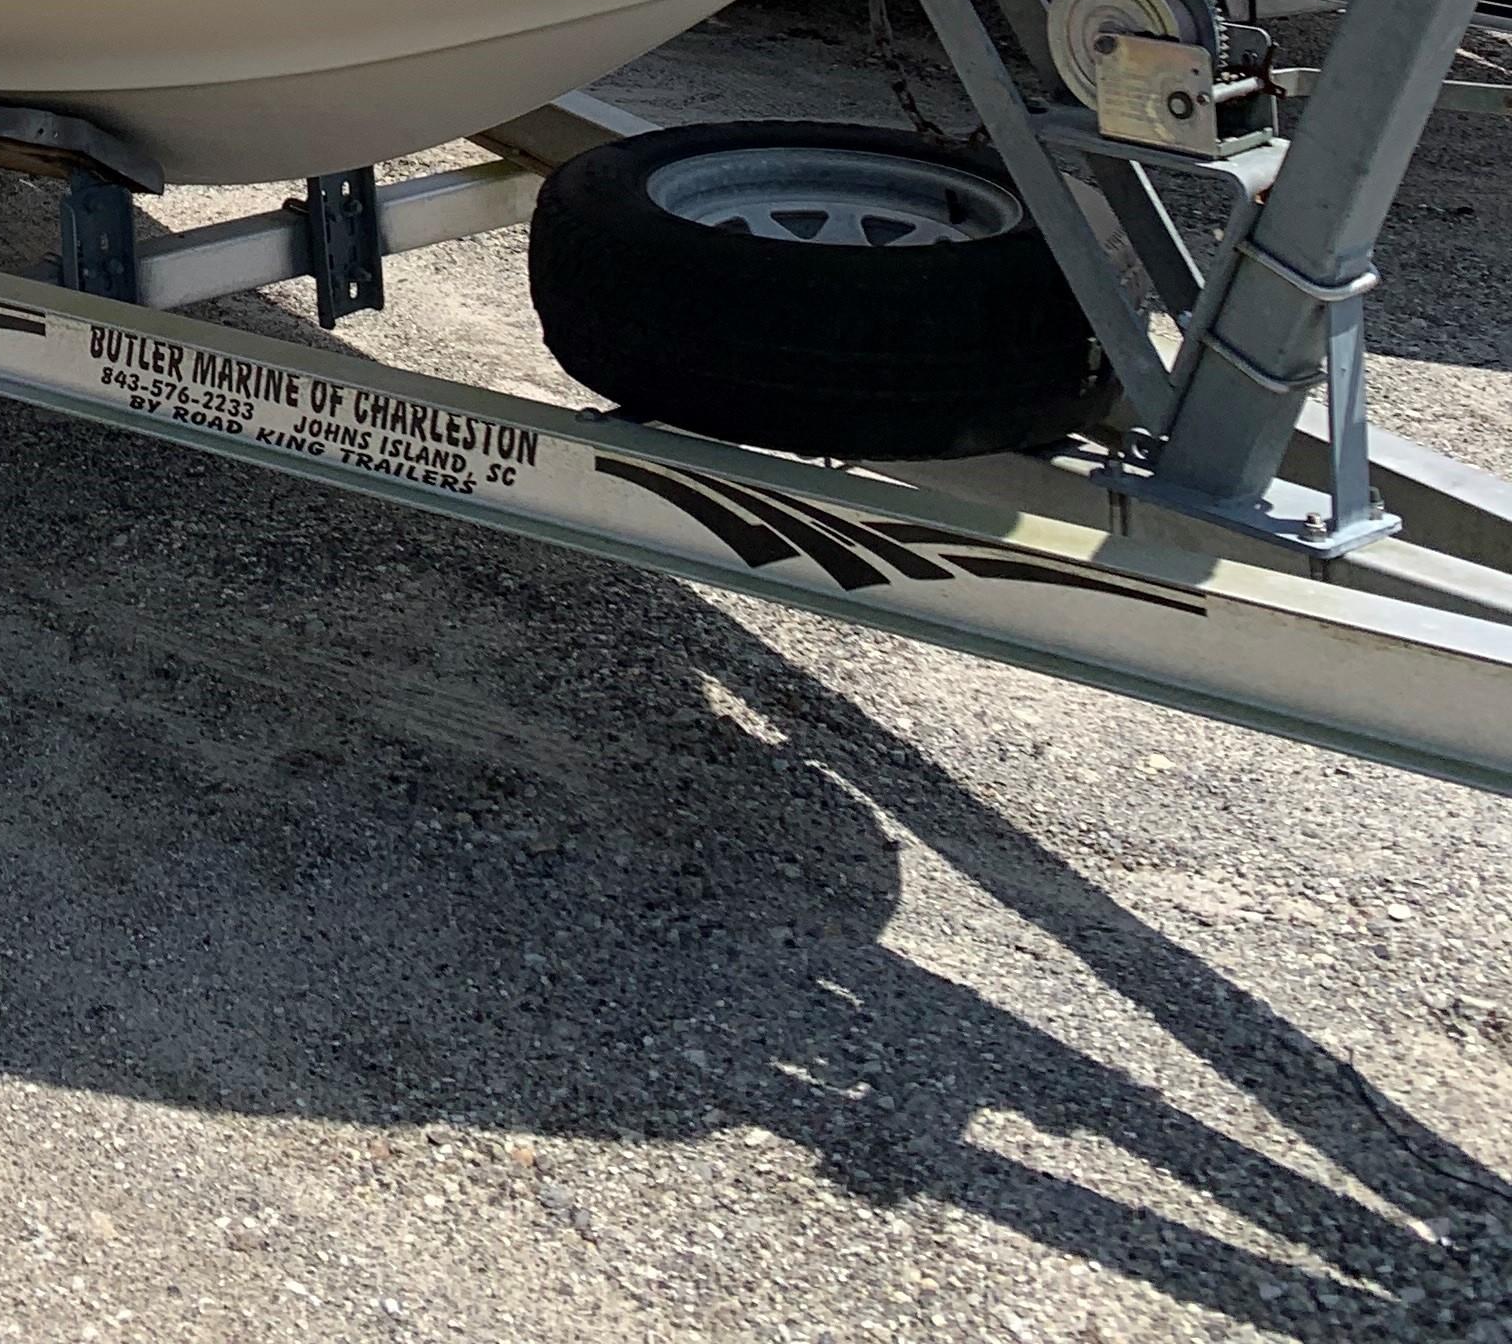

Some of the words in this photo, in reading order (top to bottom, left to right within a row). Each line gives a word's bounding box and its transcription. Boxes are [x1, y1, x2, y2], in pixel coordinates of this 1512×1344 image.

[89, 324, 184, 383] BUTLER
[191, 350, 300, 408] MARINE
[310, 380, 345, 418] OF
[353, 390, 538, 467] CHARLESTON
[100, 366, 255, 421] 843-576-2233
[293, 416, 372, 450] JOHNS
[486, 463, 517, 487] SC
[129, 395, 162, 413] BY
[172, 405, 243, 435] ROAD
[255, 427, 326, 456] KING
[340, 448, 478, 494] TRAILERS
